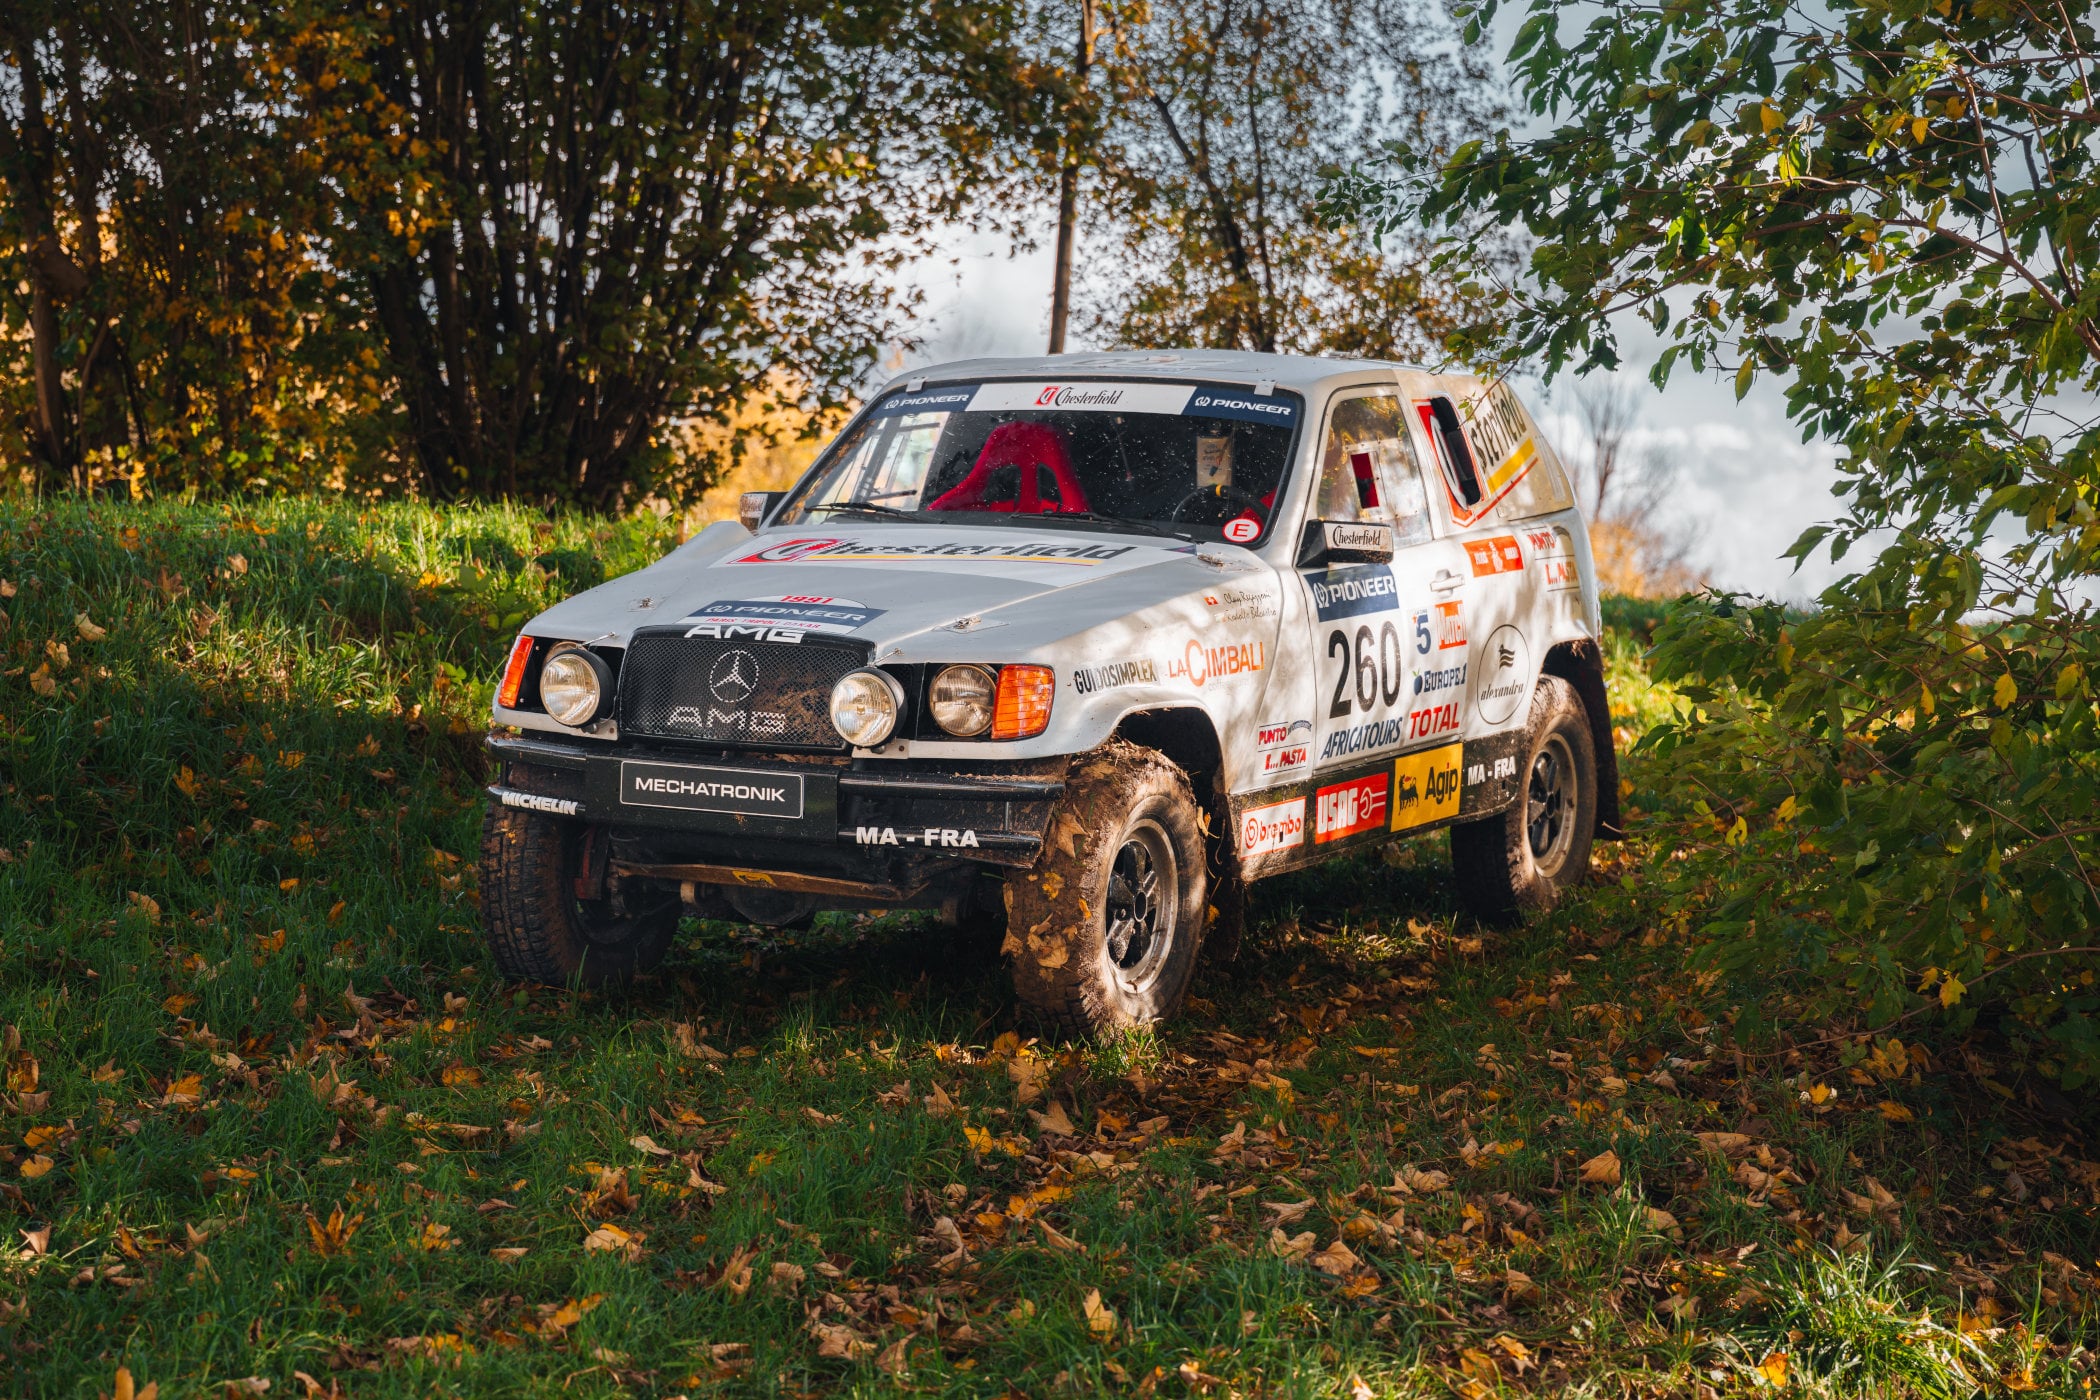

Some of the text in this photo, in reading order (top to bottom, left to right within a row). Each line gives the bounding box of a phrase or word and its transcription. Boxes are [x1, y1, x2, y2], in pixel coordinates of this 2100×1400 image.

[898, 394, 969, 407] PIONEER
[1055, 386, 1124, 406] Chesterfield
[1211, 397, 1291, 415] PIONEER
[1232, 523, 1250, 537] E
[1331, 525, 1382, 547] Chesterfield
[780, 595, 834, 605] 1991
[1331, 575, 1396, 602] PIONEER
[734, 606, 867, 622] PIONEER
[783, 620, 821, 629] DAKAR
[683, 625, 806, 643] AMG
[1416, 613, 1432, 655] 5
[1168, 657, 1187, 679] LA
[1185, 638, 1265, 688] CIMBALI
[1328, 620, 1401, 719] 260
[1074, 658, 1157, 696] GUIDOSIMPLEX
[1480, 678, 1524, 701] alexandra
[666, 706, 786, 734] AMG
[1409, 702, 1460, 739] TOTAL
[1258, 726, 1287, 746] PUNTO
[1319, 716, 1403, 760] AFRICATOURS
[1279, 747, 1307, 767] PASTA
[1468, 763, 1486, 786] MA
[1494, 756, 1516, 780] FRA
[634, 776, 786, 803] MECHATRONIK
[1424, 762, 1459, 805] Agip
[501, 791, 579, 815] MICHELIN
[1317, 786, 1358, 834] USAG
[856, 826, 899, 845] MA
[923, 828, 980, 848] FRA
[1259, 813, 1302, 843] brembo
